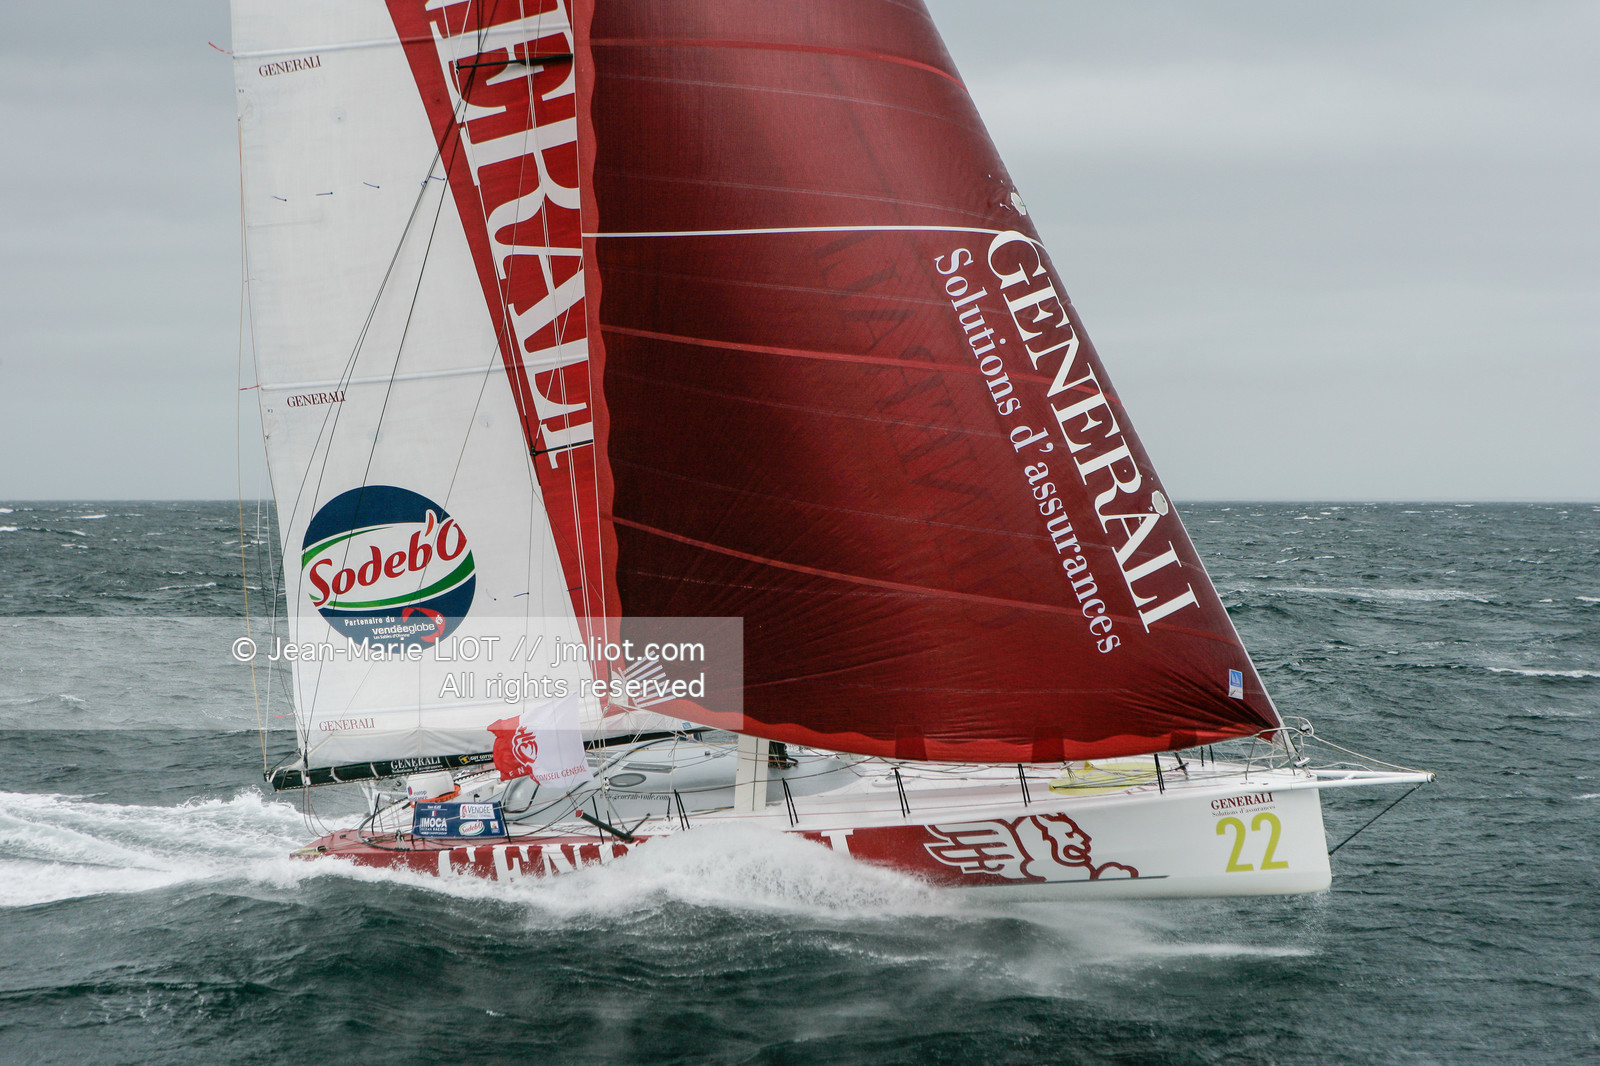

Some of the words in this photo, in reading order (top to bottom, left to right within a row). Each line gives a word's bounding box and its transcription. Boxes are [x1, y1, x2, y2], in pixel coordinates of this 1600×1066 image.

[258, 55, 322, 77] GENERALI
[424, 0, 594, 469] ERALI
[934, 247, 1022, 416] Solutions
[286, 390, 346, 408] GENERALI
[987, 230, 1200, 634] GENERALI
[344, 617, 383, 627] Partenaire
[319, 717, 376, 732] GENERALI
[390, 757, 442, 770] GENERALI
[1211, 792, 1274, 811] GENERALI
[421, 817, 447, 828] IMOCA
[1216, 812, 1289, 873] 22
